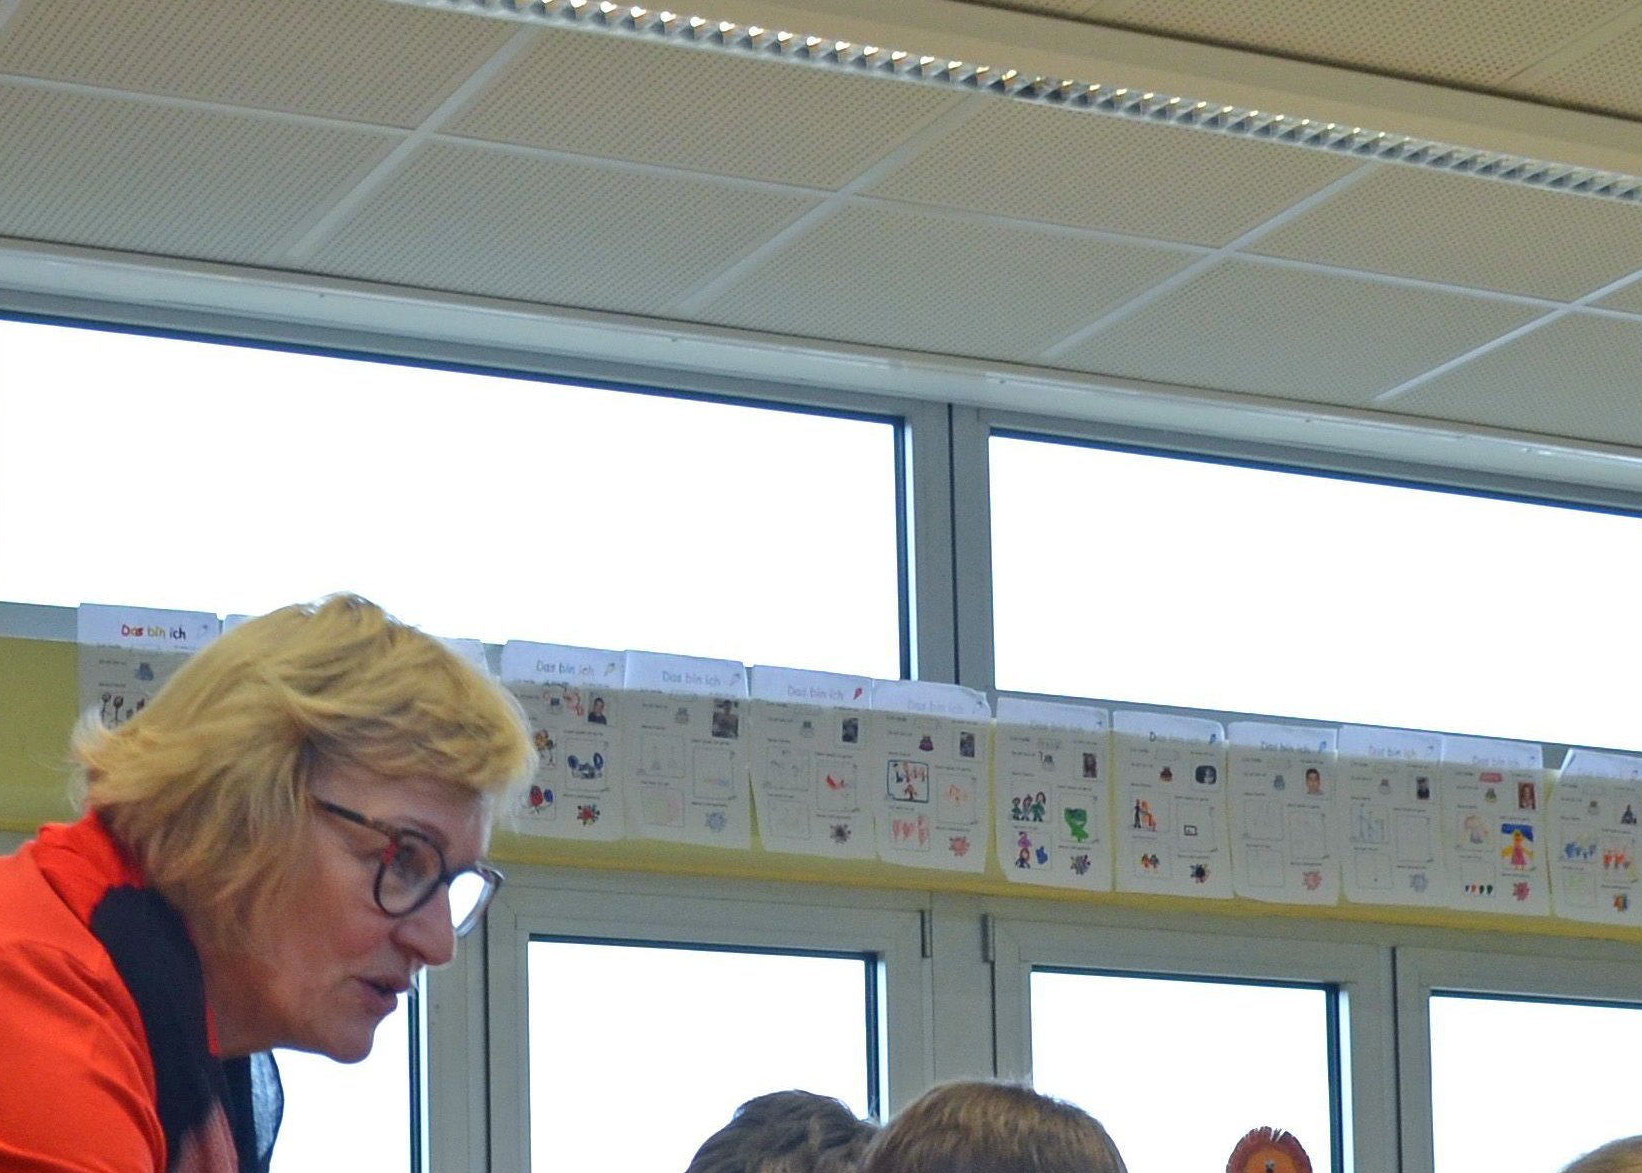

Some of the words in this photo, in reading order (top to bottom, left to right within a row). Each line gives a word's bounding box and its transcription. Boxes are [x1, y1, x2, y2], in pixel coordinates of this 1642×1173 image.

[121, 623, 144, 637] Das
[147, 625, 166, 639] bin
[169, 625, 186, 640] ich
